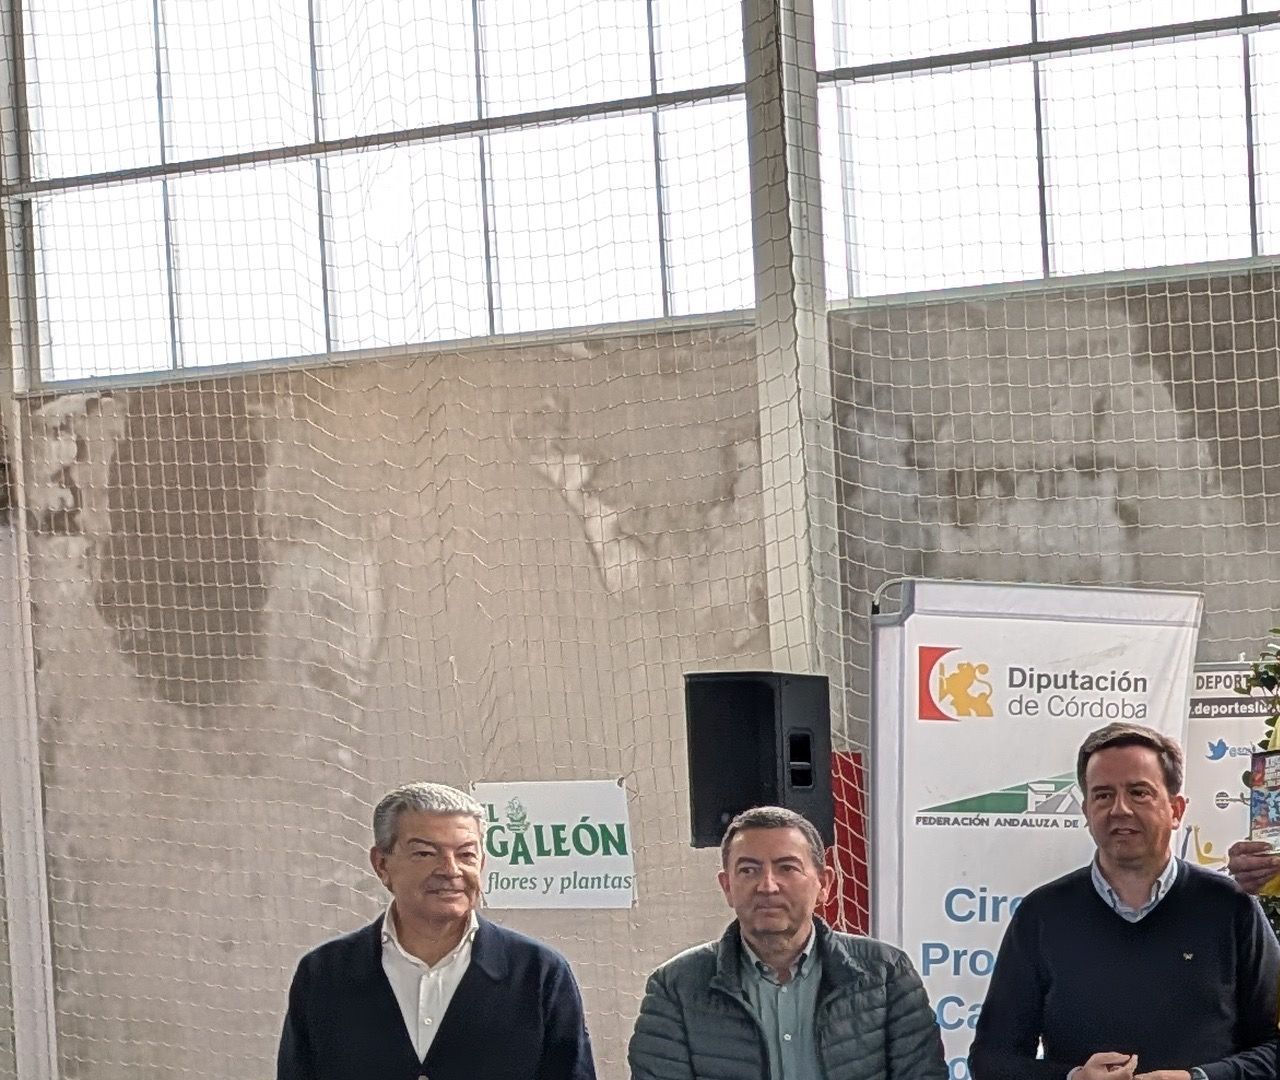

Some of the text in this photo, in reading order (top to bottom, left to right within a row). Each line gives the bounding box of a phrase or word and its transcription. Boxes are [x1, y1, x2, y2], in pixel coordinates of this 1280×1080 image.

[1008, 666, 1148, 697] Diputación
[1008, 694, 1148, 719] de Córdoba
[915, 813, 990, 828] FEDERACIÓN
[994, 817, 1060, 829] ANDALUZA
[1064, 818, 1079, 829] DE
[486, 816, 629, 866] GALEÓN
[485, 871, 633, 895] flores y plantas
